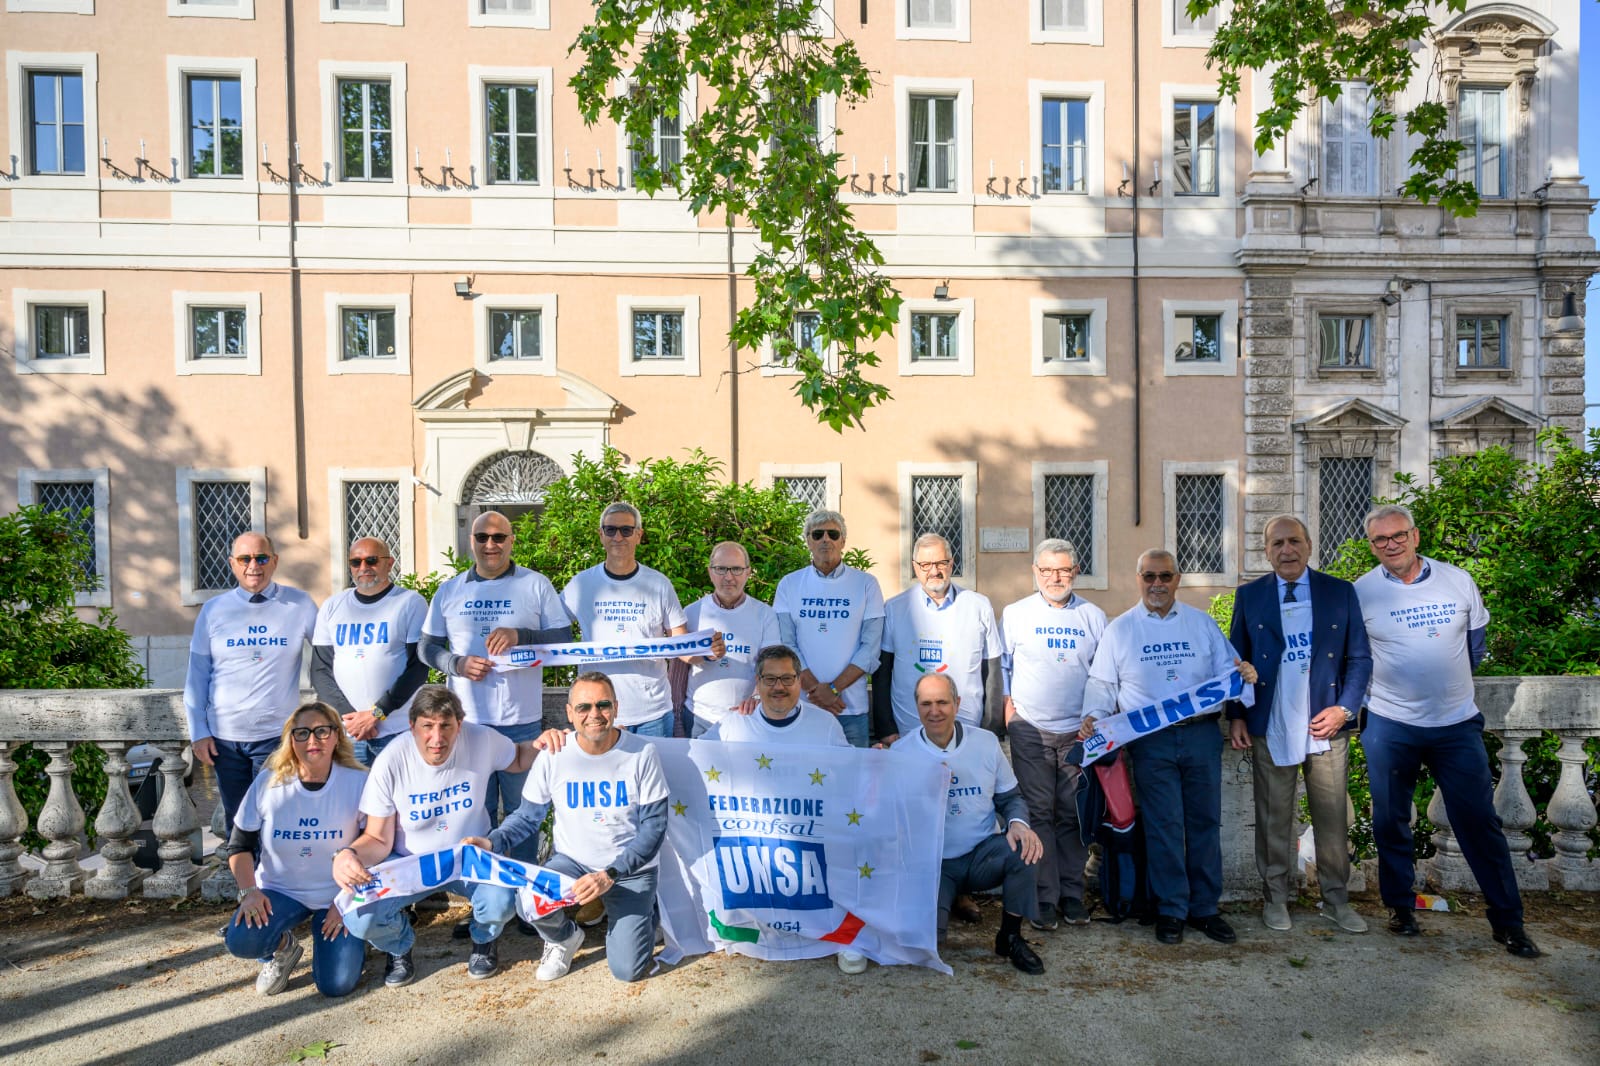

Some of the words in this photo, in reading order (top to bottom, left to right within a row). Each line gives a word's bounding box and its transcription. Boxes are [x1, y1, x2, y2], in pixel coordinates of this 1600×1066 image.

[465, 600, 512, 608] CORTE
[802, 598, 850, 606] TFR/TFS
[800, 609, 850, 619] SUBITO
[1390, 604, 1438, 617] RISPETTO
[1406, 609, 1456, 622] PUBBLICO
[1408, 617, 1451, 628] IMPIEGO
[248, 625, 268, 633] NO
[336, 622, 389, 647] UNSA
[1035, 627, 1085, 637] RICORSO
[226, 637, 288, 647] BANCHE
[1047, 638, 1076, 649] UNSA
[1287, 631, 1313, 649] NS
[603, 646, 627, 656] CI
[634, 637, 712, 655] SIAMO
[726, 644, 751, 654] CHE
[1143, 642, 1191, 654] CORTE
[512, 651, 535, 662] UNSA
[921, 650, 941, 660] UNSA
[1140, 652, 1196, 662] COSTITUZIONALE
[408, 781, 471, 805] TFR/TFS
[566, 780, 629, 809] UNSA
[948, 786, 982, 798] STITI
[410, 798, 473, 822] SUBITO
[709, 795, 824, 817] FEDERAZIONE
[299, 817, 319, 827] NO
[722, 818, 815, 836] confsal
[273, 829, 343, 840] PRESTITI
[419, 845, 563, 901] UNSA
[719, 845, 827, 897] UNSA
